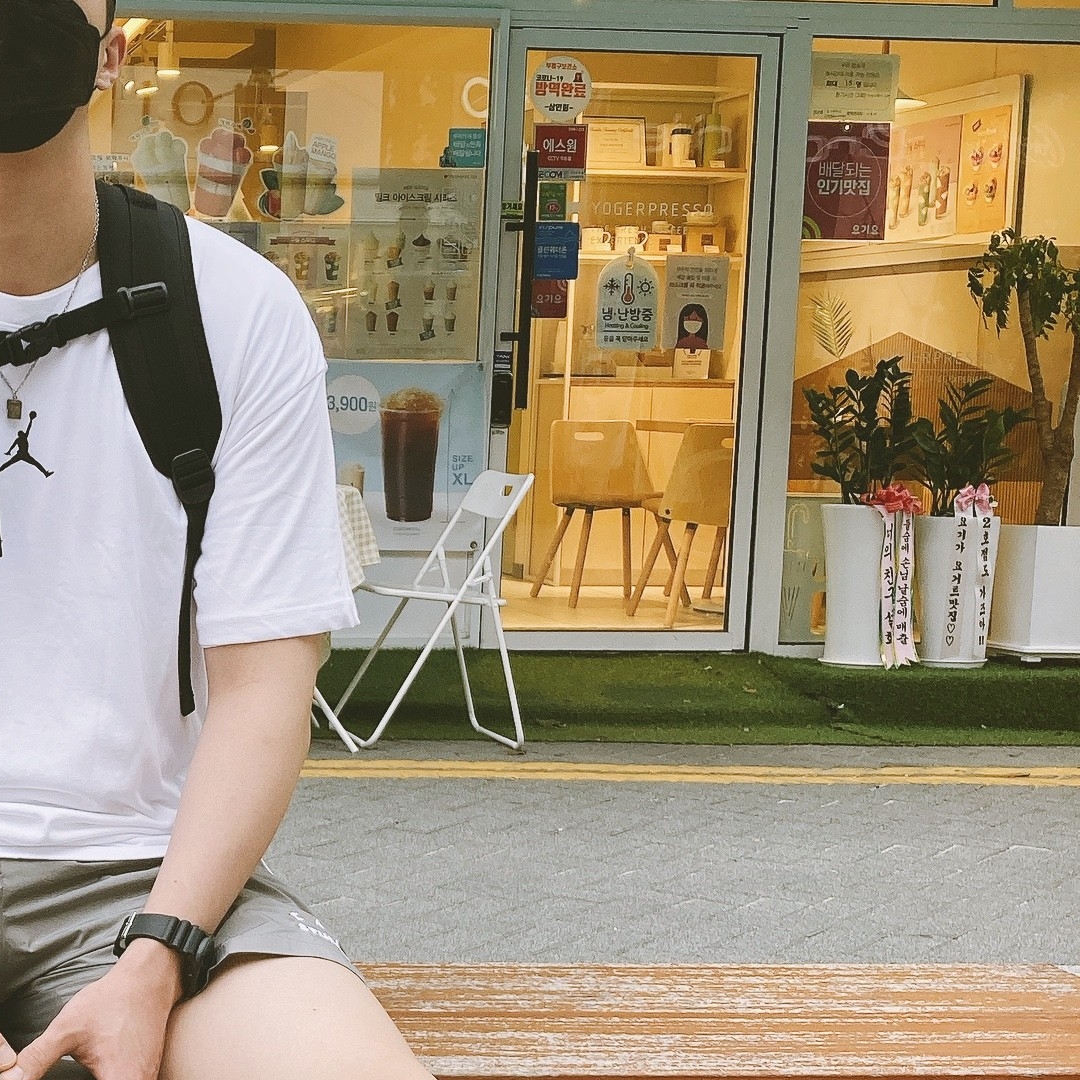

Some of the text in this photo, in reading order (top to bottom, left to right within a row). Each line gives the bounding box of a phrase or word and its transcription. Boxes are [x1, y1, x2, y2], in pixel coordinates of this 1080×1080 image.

[535, 82, 586, 98] 방역완료
[543, 139, 577, 153] 에스원
[819, 161, 872, 178] 배달되는
[817, 179, 871, 195] 인기맛집
[392, 192, 432, 202] 아이스크림
[592, 201, 714, 216] YOGERPRESSO
[852, 224, 879, 235] 요기요
[536, 294, 562, 304] 요기요
[602, 306, 653, 321] 냉·난방중
[452, 454, 473, 463] SIZE
[452, 463, 465, 471] UP
[452, 473, 473, 486] XL
[956, 517, 967, 553] 요기가
[900, 557, 911, 581] 손님
